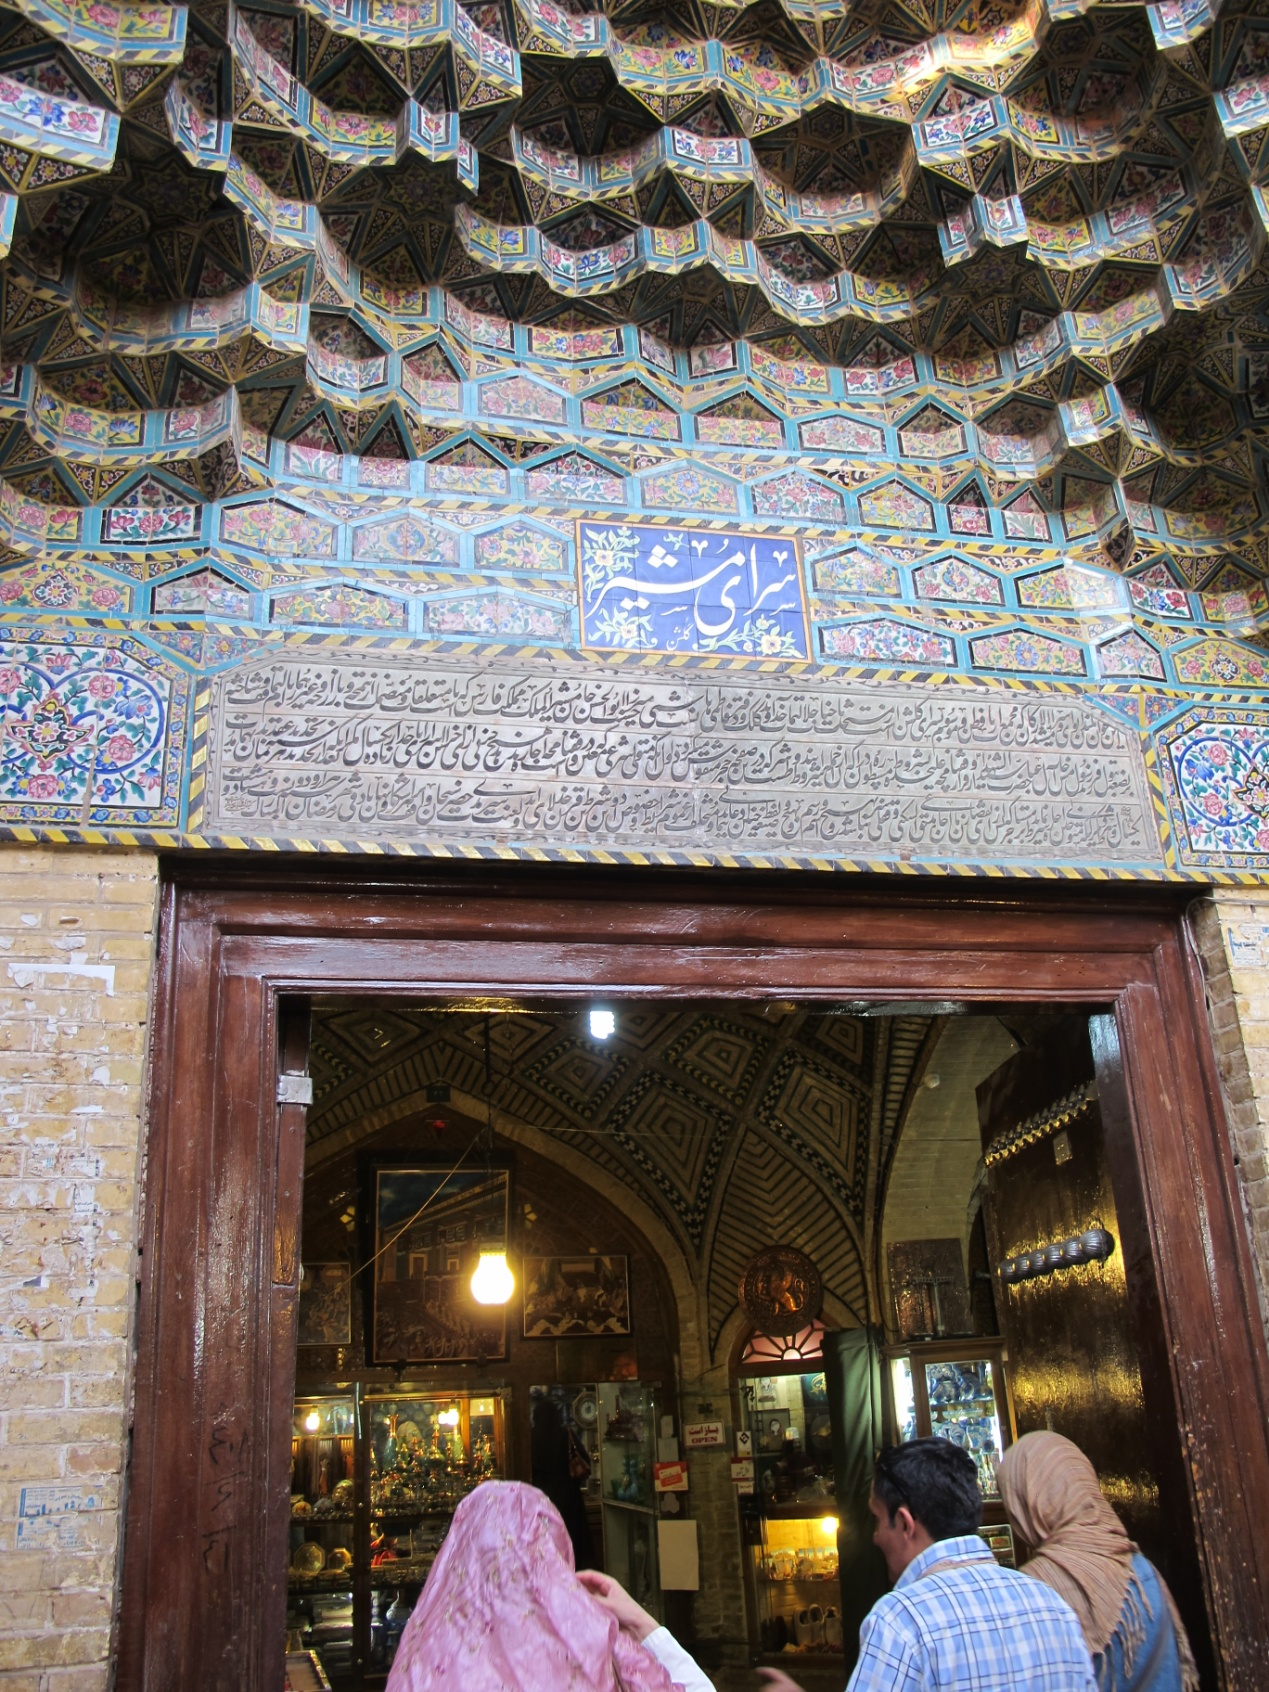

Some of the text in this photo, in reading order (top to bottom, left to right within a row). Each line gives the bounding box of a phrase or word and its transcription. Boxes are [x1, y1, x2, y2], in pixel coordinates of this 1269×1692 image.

[584, 539, 797, 636] سرای مشیر
[691, 1436, 718, 1444] OPEN
